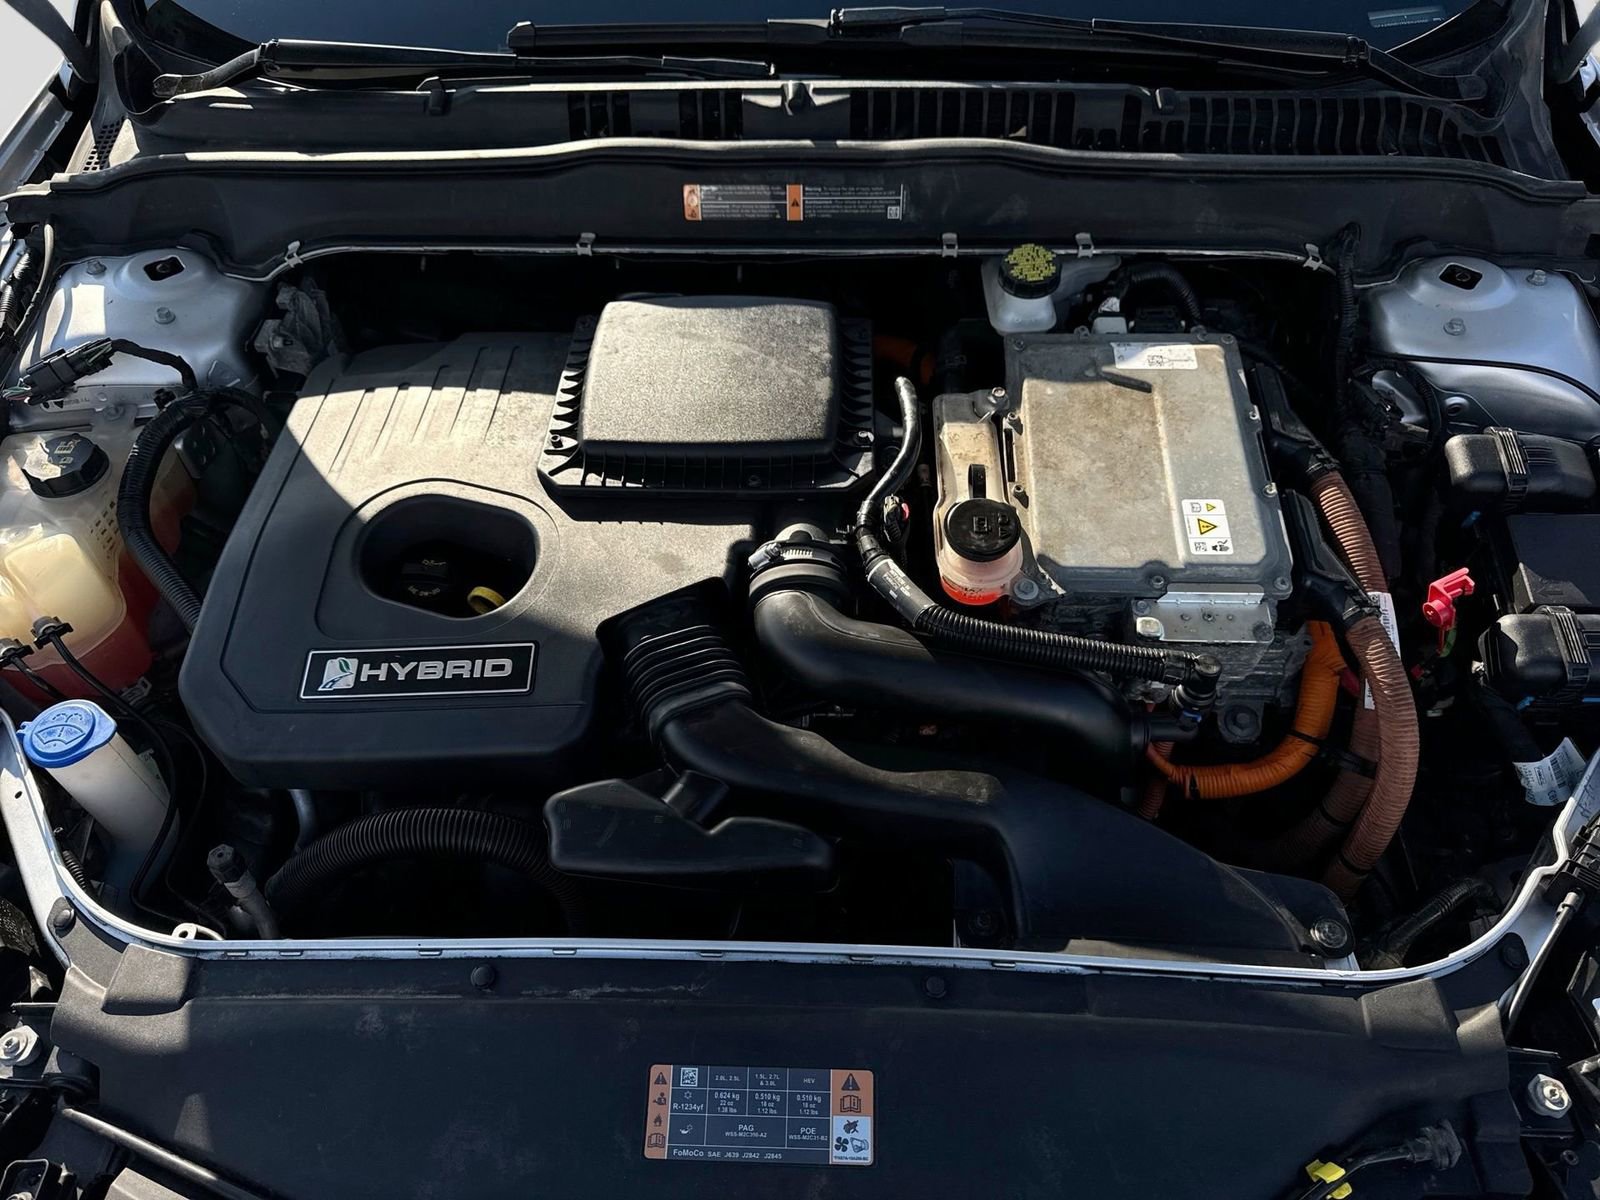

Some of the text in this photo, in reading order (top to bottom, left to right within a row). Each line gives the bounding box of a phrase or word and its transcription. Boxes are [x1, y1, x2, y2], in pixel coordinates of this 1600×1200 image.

[359, 658, 513, 682] HYBRID
[714, 1091, 740, 1101] 0.624 kg
[754, 1092, 781, 1102] 0.510 kg
[796, 1094, 822, 1104] 0.510 kg
[672, 1102, 704, 1113] R-1234yf
[738, 1124, 755, 1132] PAG
[800, 1127, 817, 1135] POE
[673, 1149, 704, 1157] FoMoCo
[724, 1151, 740, 1159] J639
